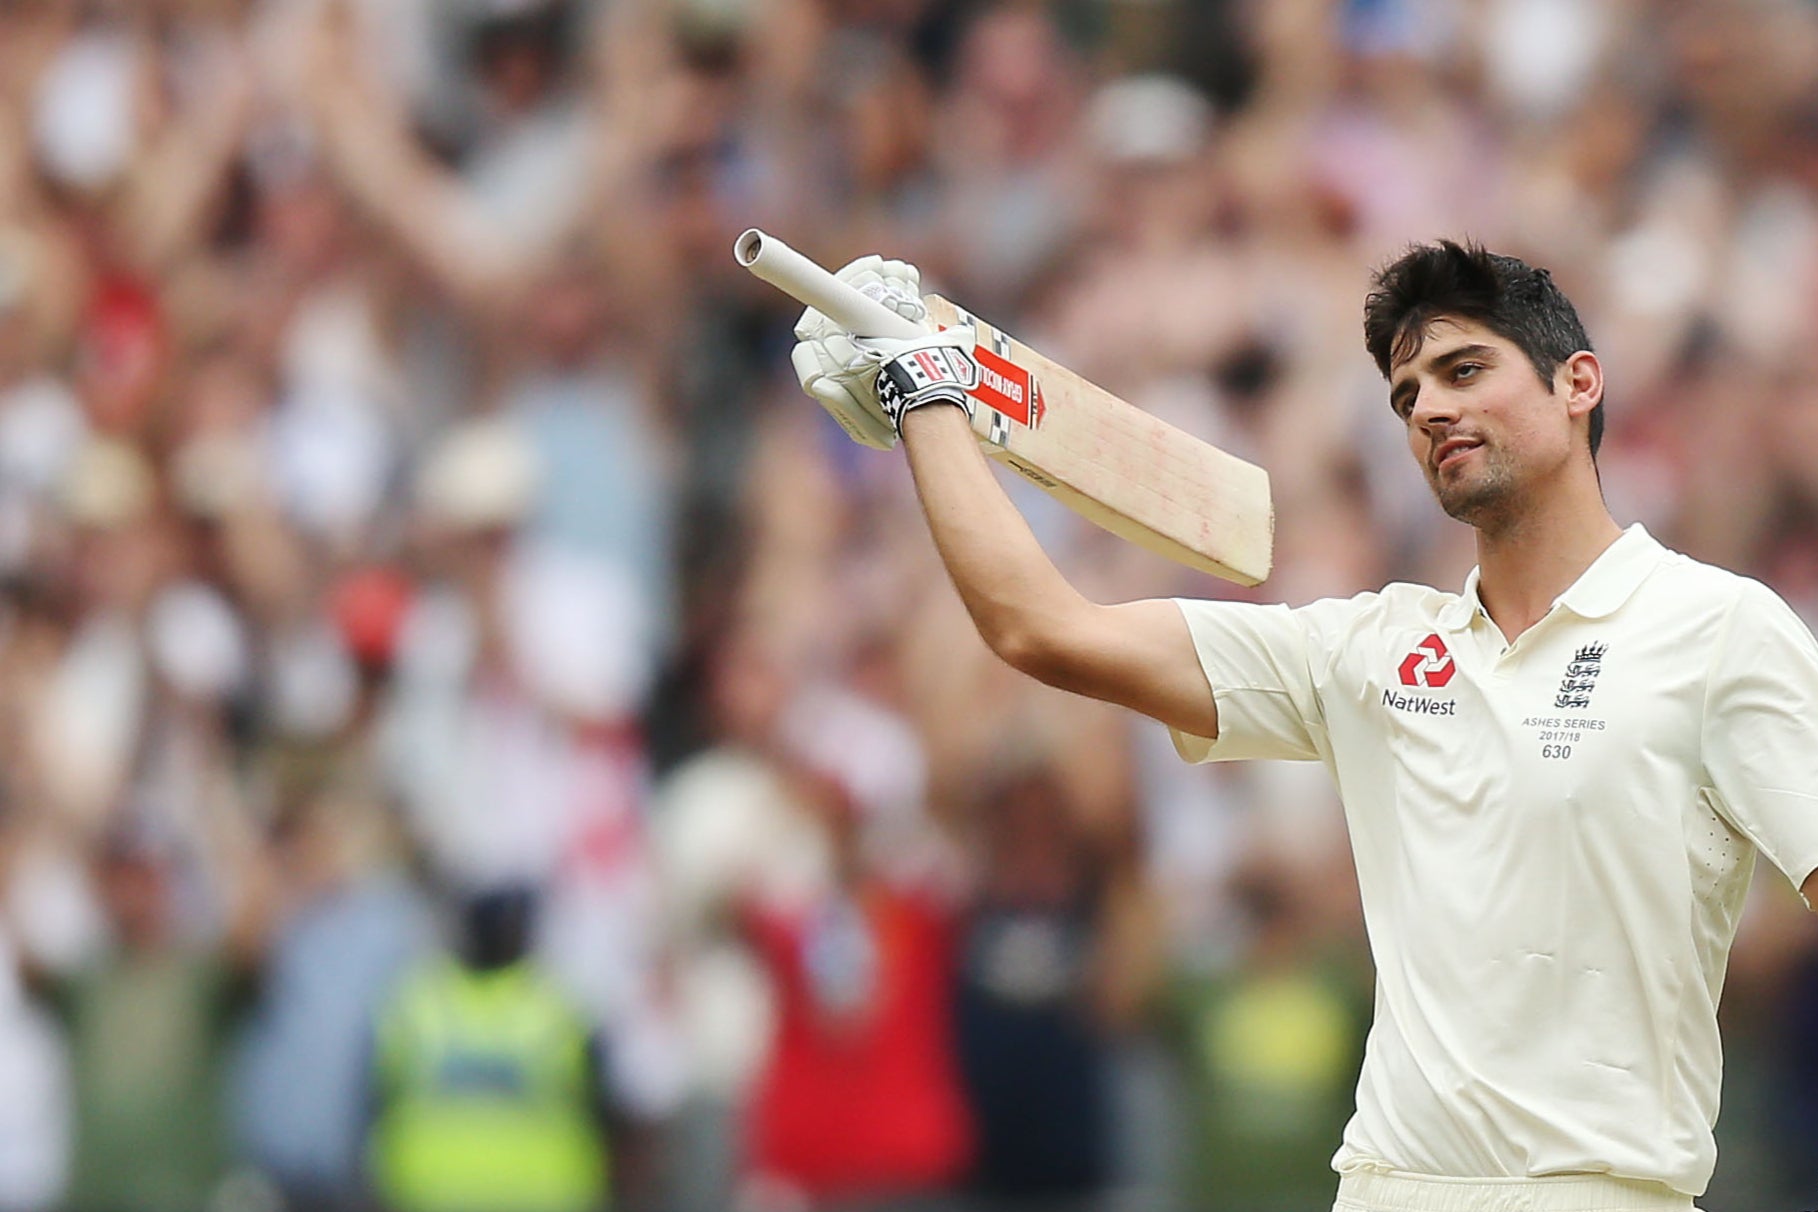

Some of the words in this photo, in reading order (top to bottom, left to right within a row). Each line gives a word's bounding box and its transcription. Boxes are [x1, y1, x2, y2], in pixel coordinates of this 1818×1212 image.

[1382, 689, 1456, 716] NatWest
[1522, 717, 1561, 728] ASHES
[1563, 718, 1606, 730] SERIES
[1539, 730, 1581, 742] 2017/18
[1542, 744, 1572, 760] 630
